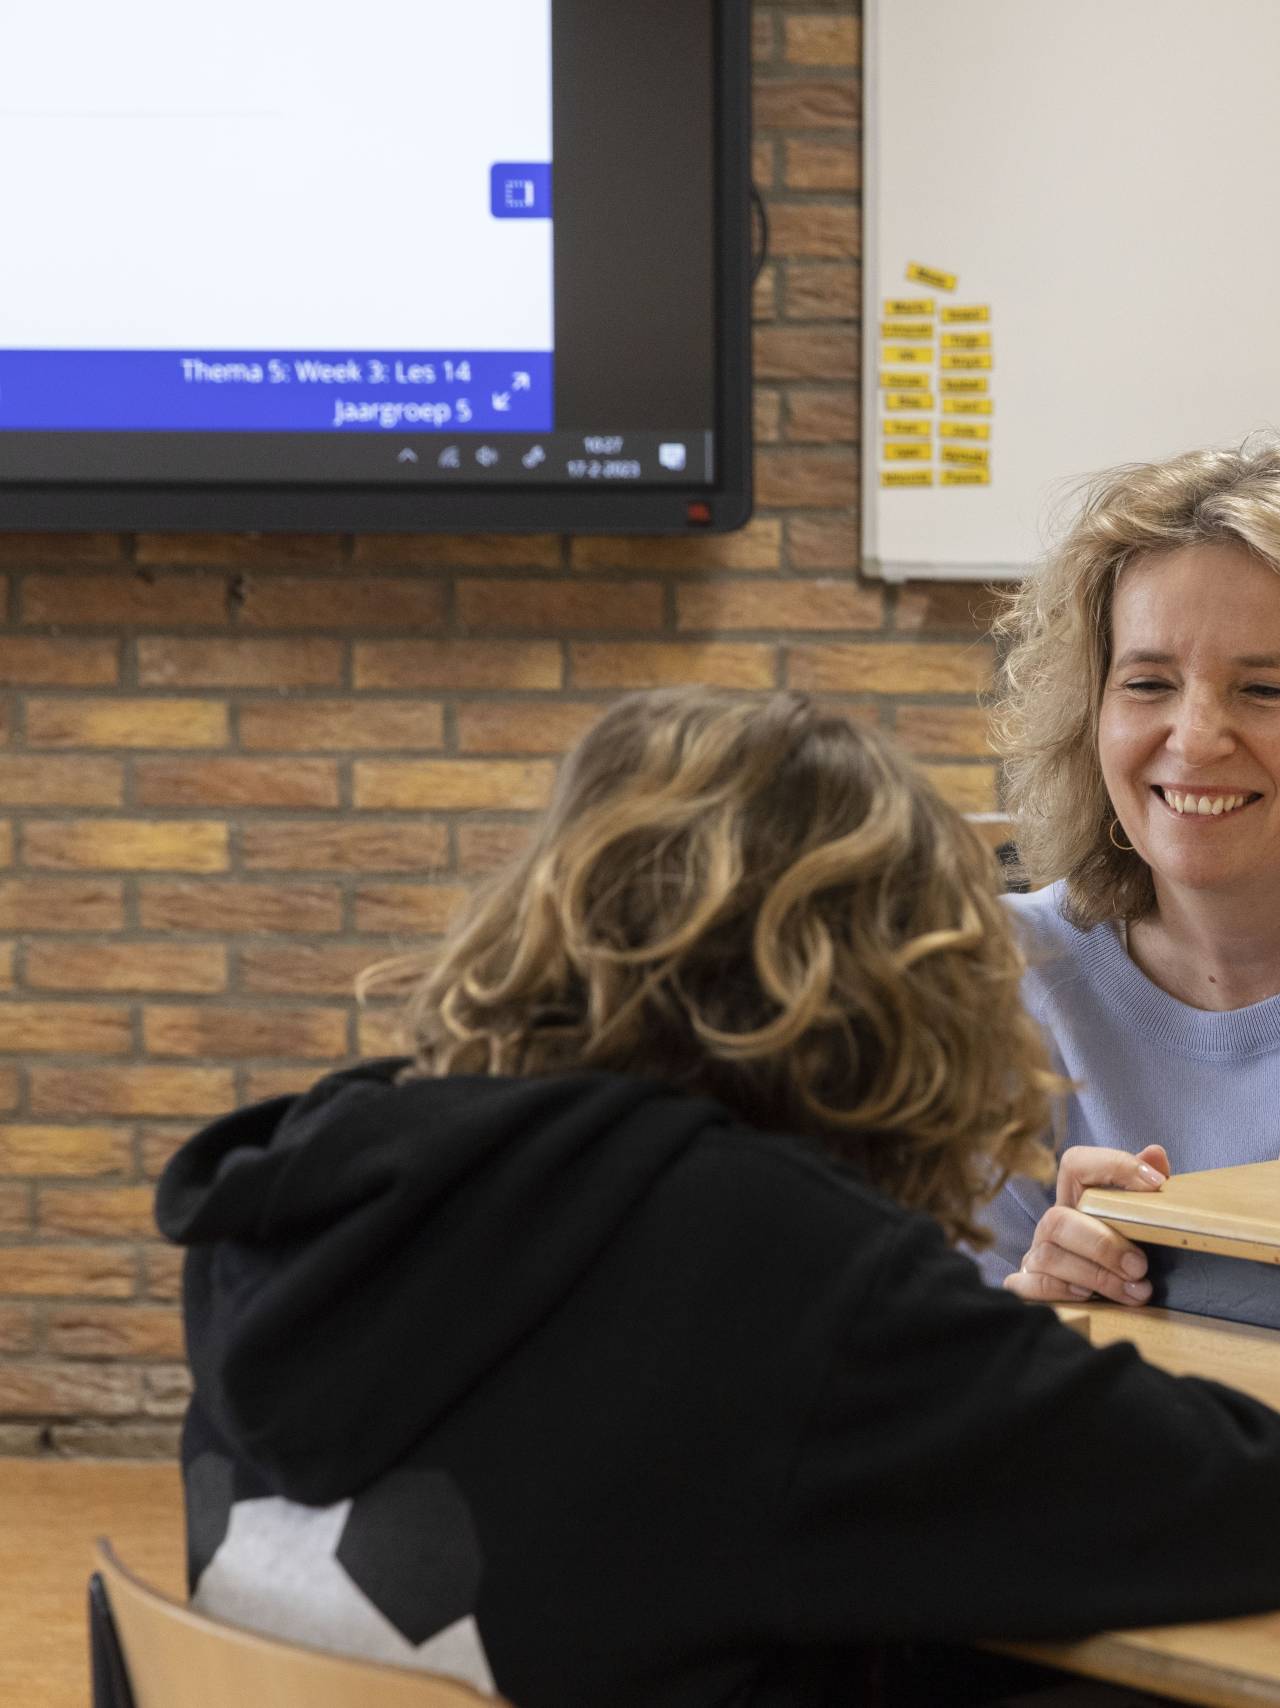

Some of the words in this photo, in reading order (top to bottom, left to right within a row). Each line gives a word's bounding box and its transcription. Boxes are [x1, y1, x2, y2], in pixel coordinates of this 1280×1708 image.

[181, 358, 264, 383] Thema
[267, 358, 291, 384] 5:
[294, 359, 361, 384] Week
[366, 360, 390, 384] 3:
[395, 360, 436, 384] Les
[442, 360, 472, 383] 14
[333, 398, 452, 428] Jaargroep
[455, 398, 473, 423] 5
